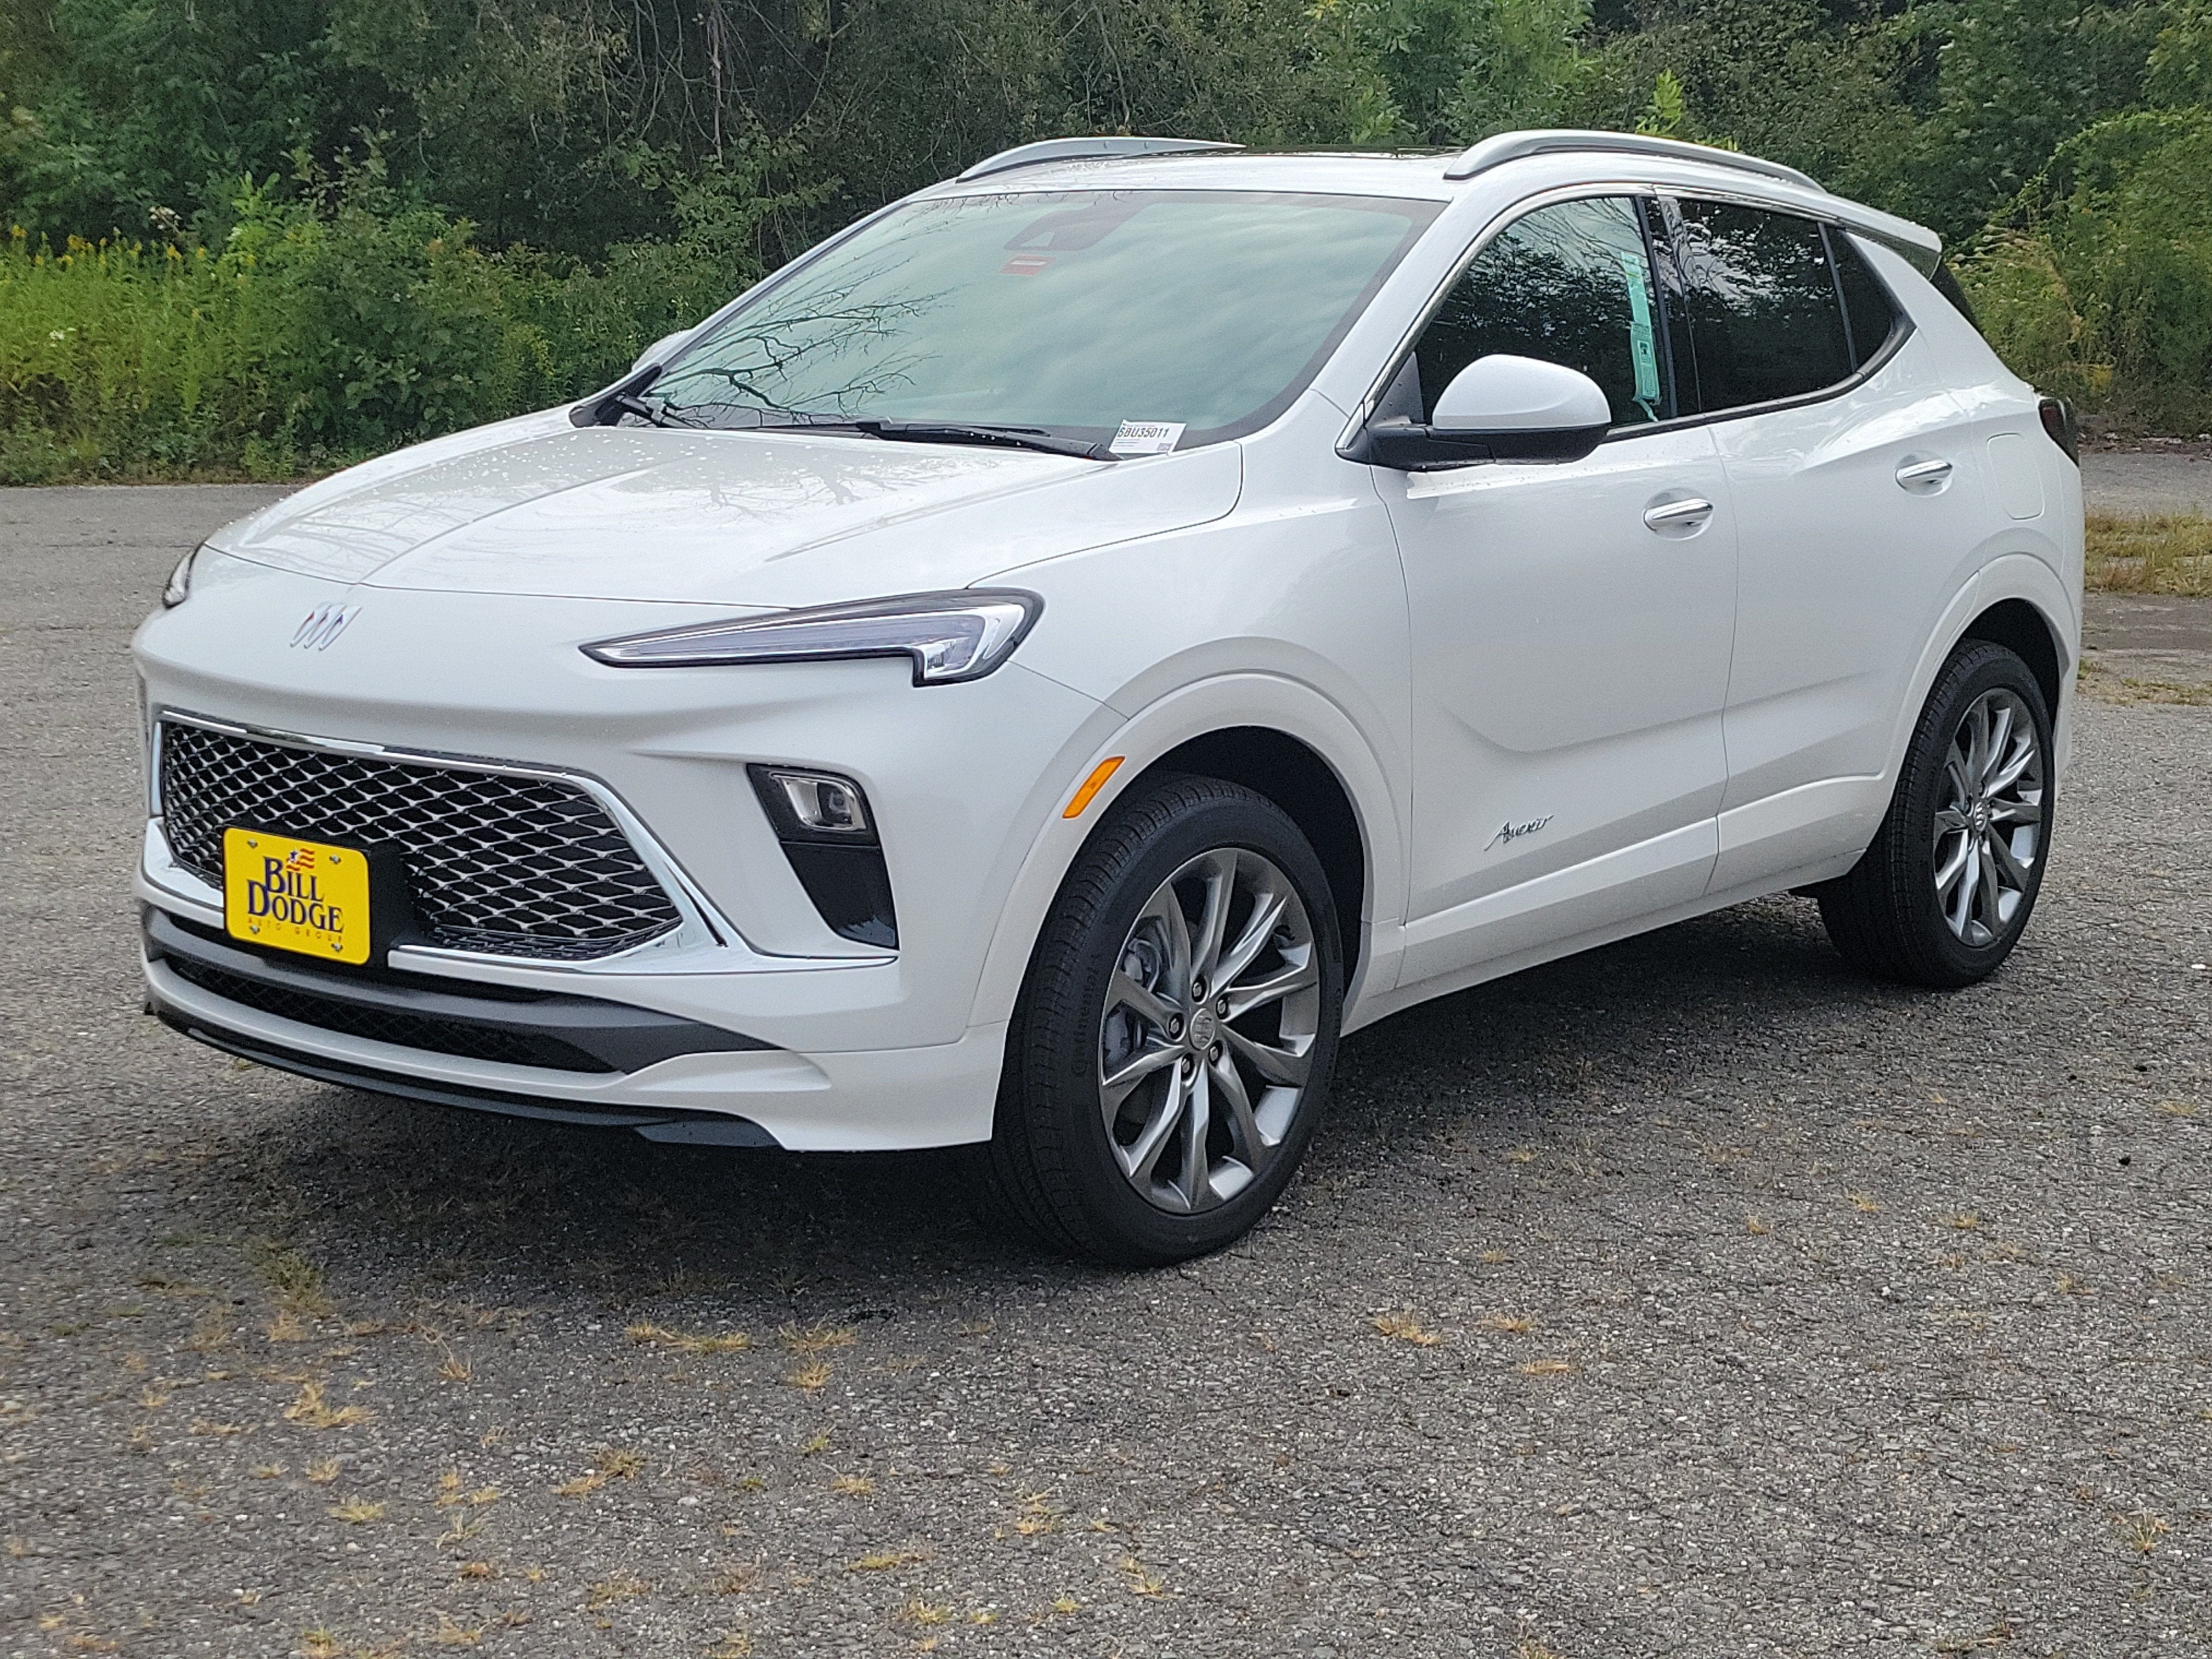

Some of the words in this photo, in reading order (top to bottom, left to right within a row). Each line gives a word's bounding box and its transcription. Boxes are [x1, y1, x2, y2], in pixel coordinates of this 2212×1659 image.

[1484, 814, 1554, 851] Avenir
[263, 856, 325, 902] BILL
[247, 879, 344, 933] DODGE
